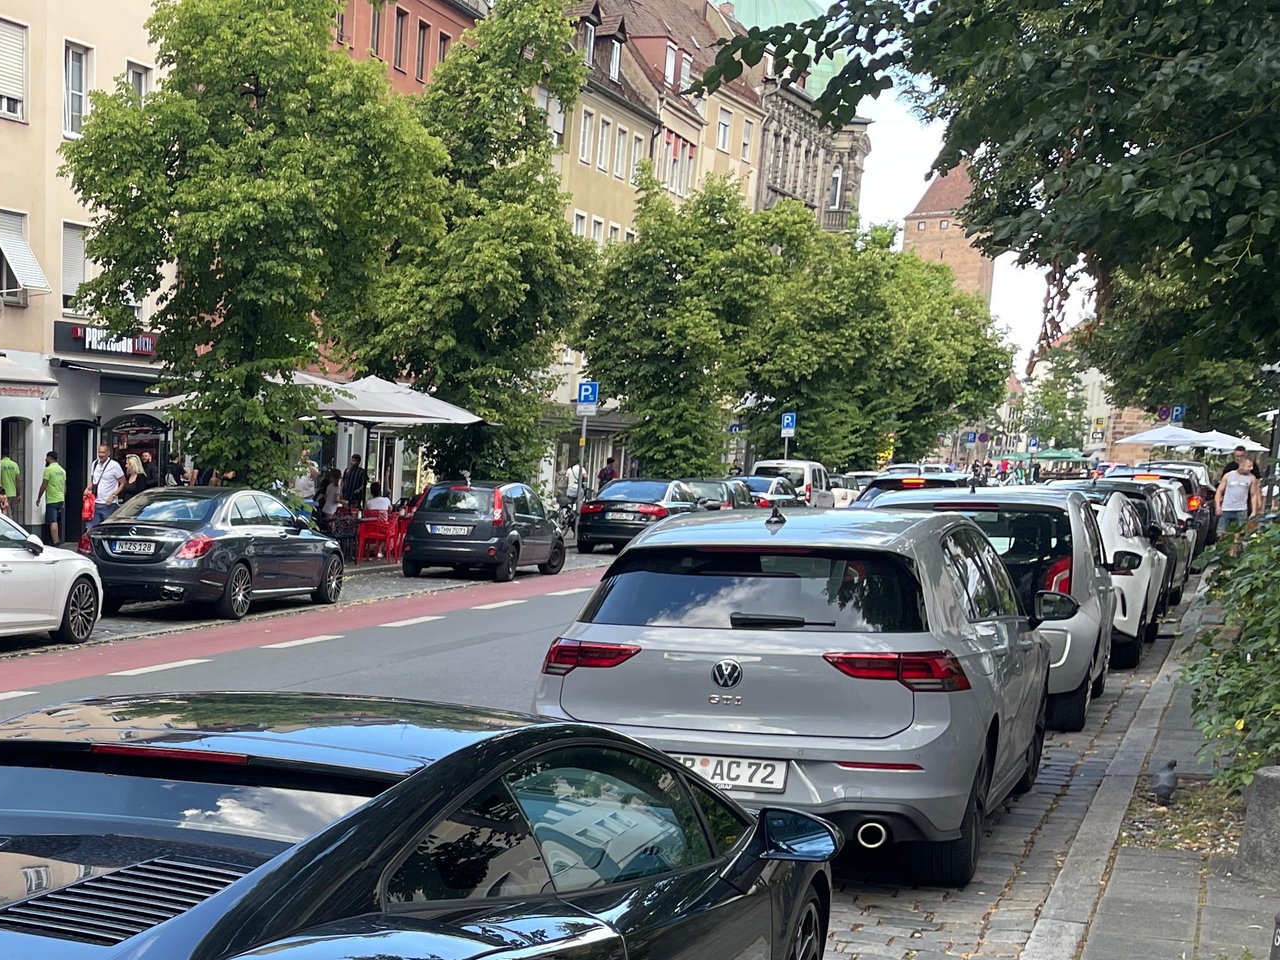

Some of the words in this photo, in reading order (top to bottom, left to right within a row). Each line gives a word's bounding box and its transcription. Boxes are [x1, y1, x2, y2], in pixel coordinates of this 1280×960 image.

[580, 385, 593, 402] P
[1172, 406, 1181, 419] P
[784, 415, 792, 427] P
[127, 542, 137, 551] ZS
[138, 543, 152, 552] 128
[708, 694, 742, 706] GTI
[710, 759, 741, 782] AC
[747, 761, 776, 785] 72
